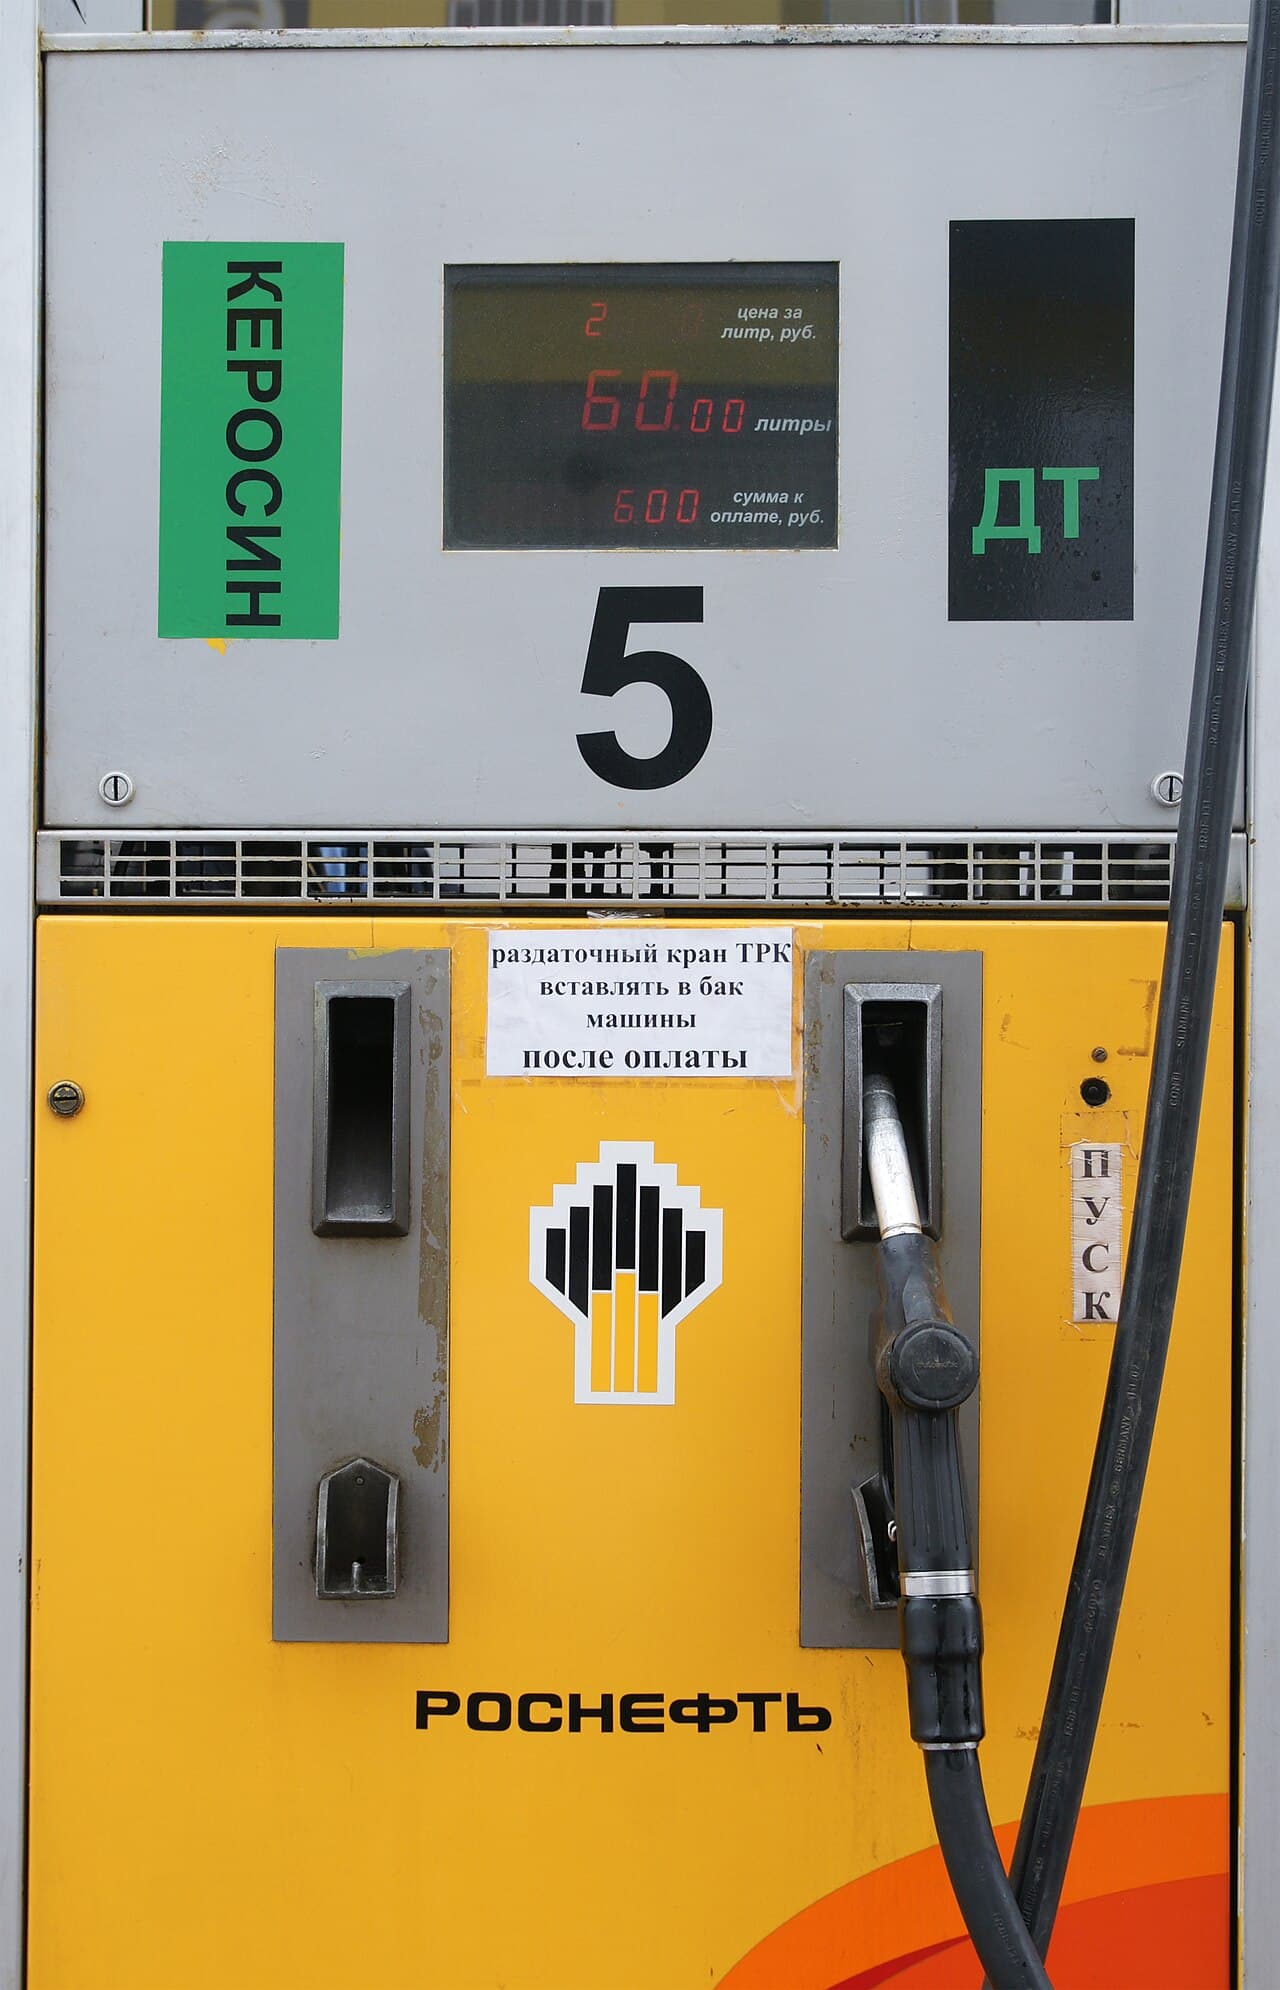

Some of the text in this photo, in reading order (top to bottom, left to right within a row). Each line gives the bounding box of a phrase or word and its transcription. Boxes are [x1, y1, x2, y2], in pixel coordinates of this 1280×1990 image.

[738, 307, 803, 321] цена за
[721, 324, 817, 343] литр, руб.
[755, 417, 832, 436] литры
[226, 262, 282, 626] КЕРОСИН
[733, 491, 805, 507] сумма к
[710, 508, 825, 527] оплате, руб.
[972, 467, 1099, 555] ДТ
[576, 586, 713, 790] 5
[492, 942, 791, 969] раздаточный кран ТРК
[540, 974, 744, 996] вставлять в бак
[586, 1012, 697, 1028] машины
[523, 1048, 748, 1069] после оплаты
[1081, 1149, 1111, 1320] ПУСК
[416, 1690, 832, 1733] РОСНЕФТЬ
